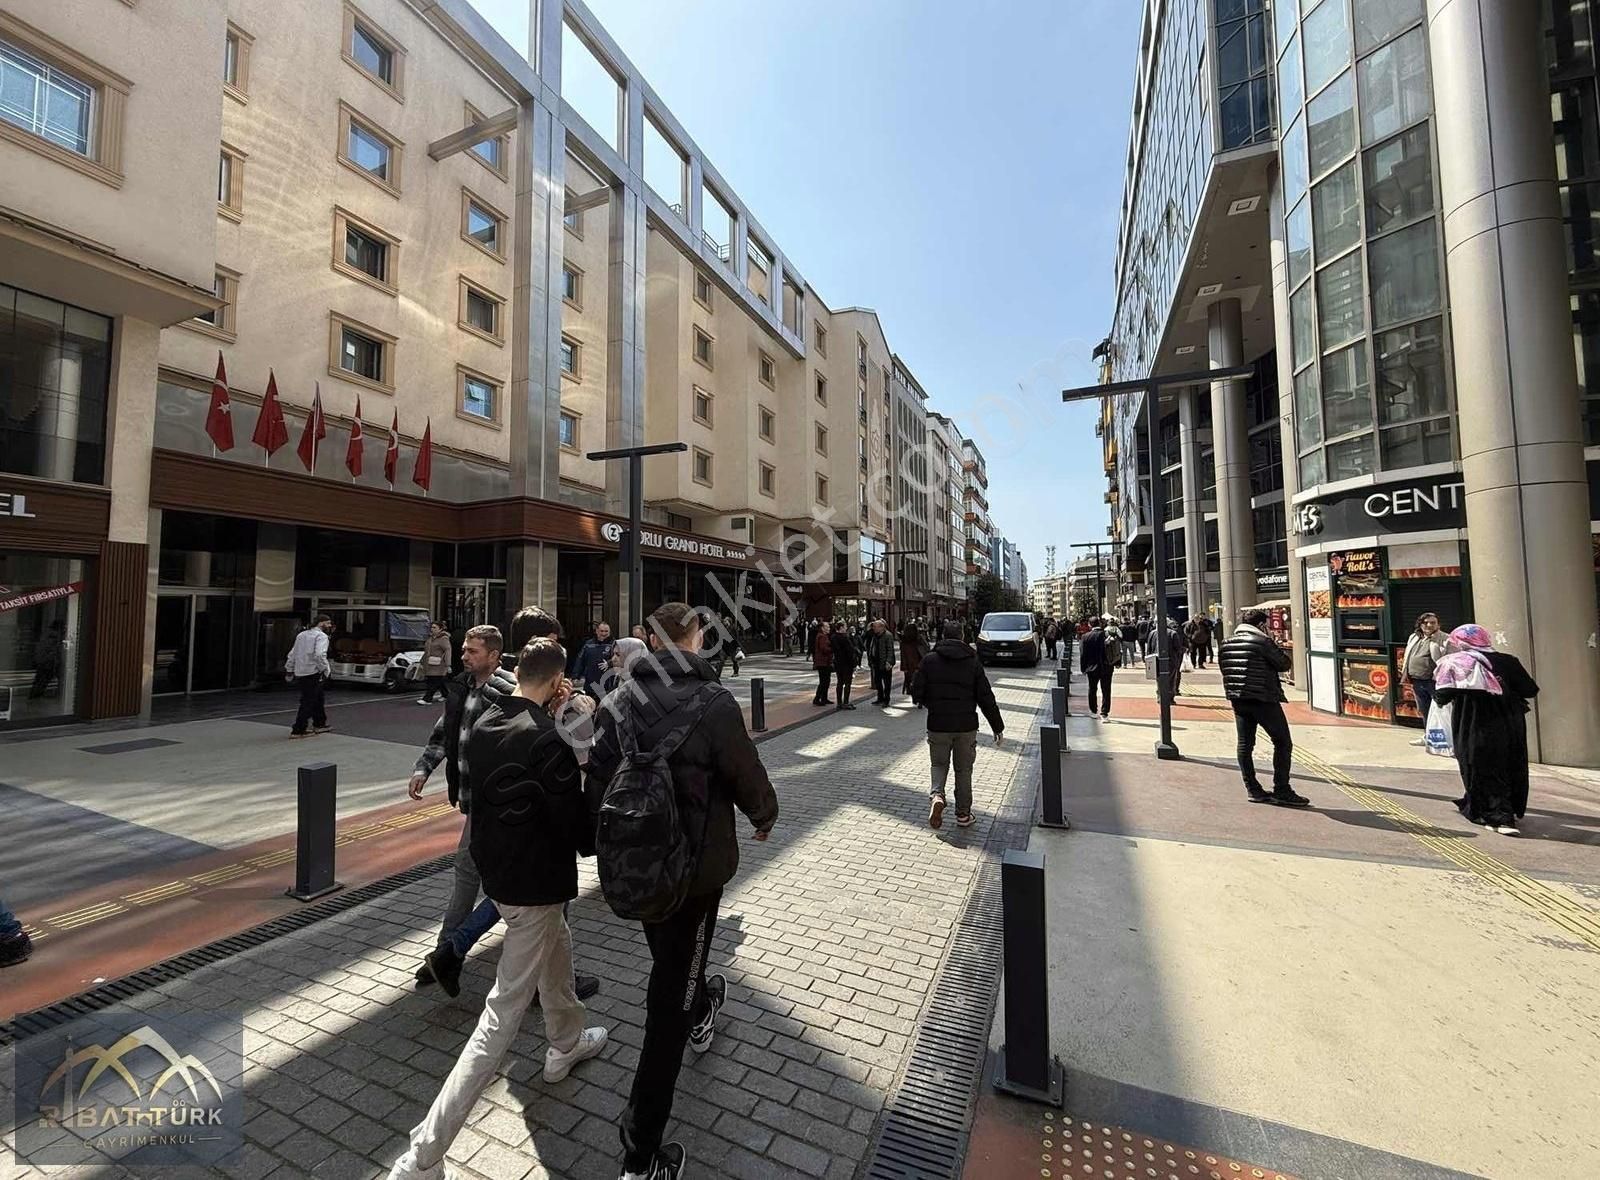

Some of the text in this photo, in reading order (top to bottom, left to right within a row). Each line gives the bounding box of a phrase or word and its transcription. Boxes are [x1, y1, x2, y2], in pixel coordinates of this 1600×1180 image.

[640, 530, 662, 547] RLU
[664, 536, 698, 554] GRAND
[699, 542, 724, 559] HOTEL
[1257, 575, 1288, 585] vodafone
